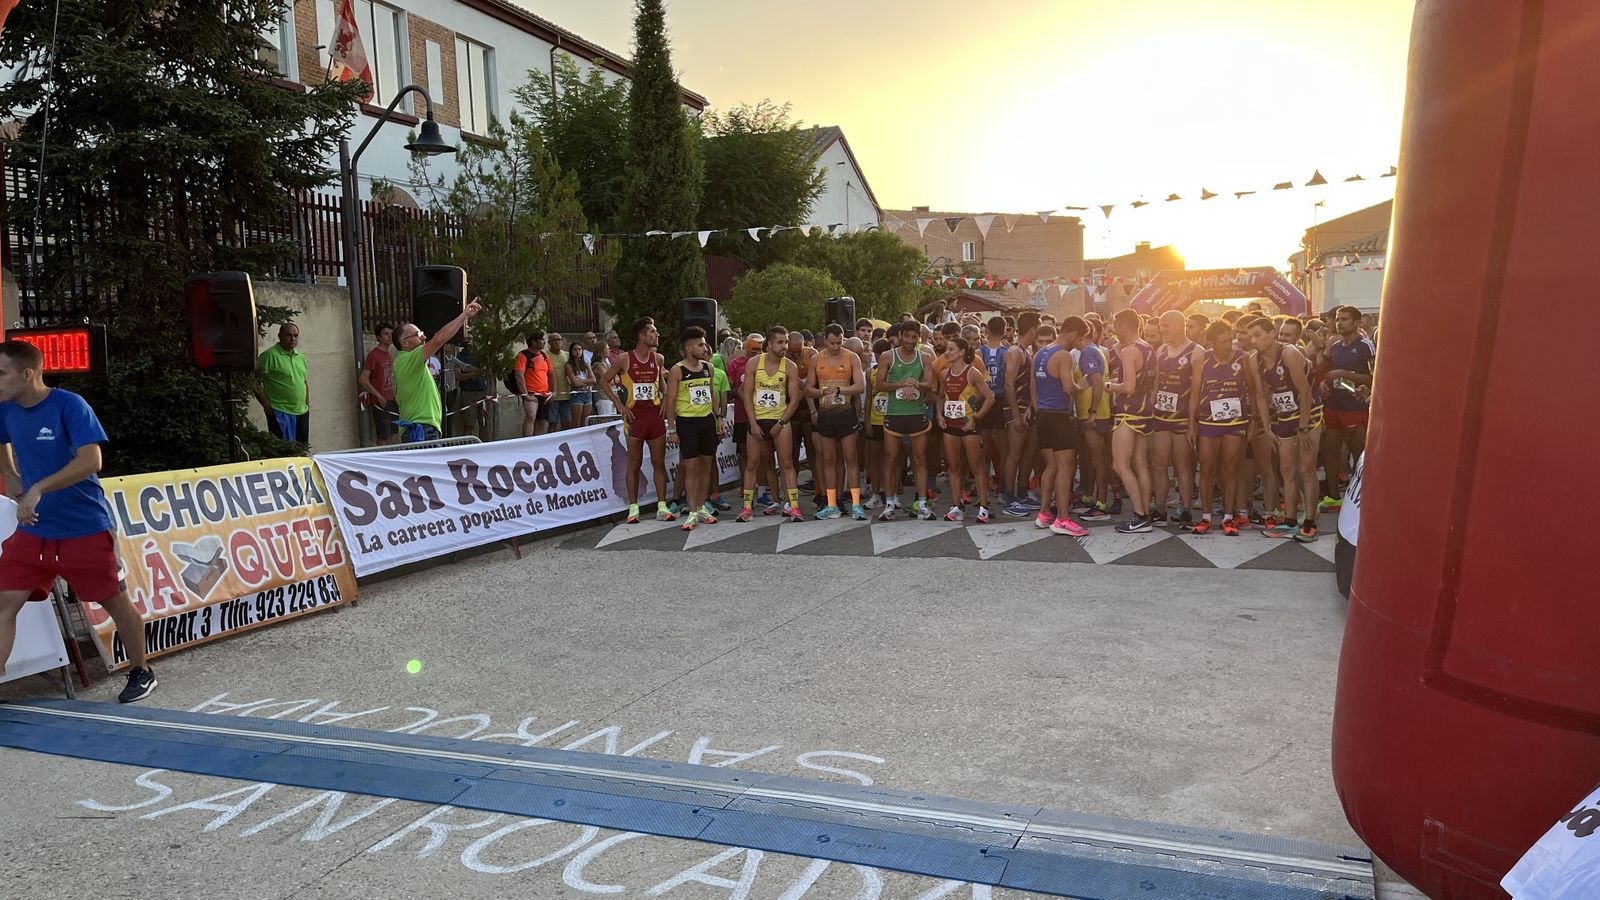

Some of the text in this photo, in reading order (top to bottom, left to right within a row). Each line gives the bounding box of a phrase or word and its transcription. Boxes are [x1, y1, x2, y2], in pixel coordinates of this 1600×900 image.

[636, 386, 653, 394] 192
[695, 389, 707, 398] 96
[761, 393, 775, 401] 44
[1158, 394, 1174, 404] 231
[946, 403, 963, 412] 474
[1222, 402, 1230, 411] 3
[717, 452, 739, 474] piern
[336, 442, 600, 526] San Rocada
[106, 464, 324, 537] LCHONERÍA
[355, 486, 608, 554] La carrera popular de Macotera
[200, 606, 212, 638] 3
[255, 587, 286, 622] 923
[287, 579, 318, 614] 229
